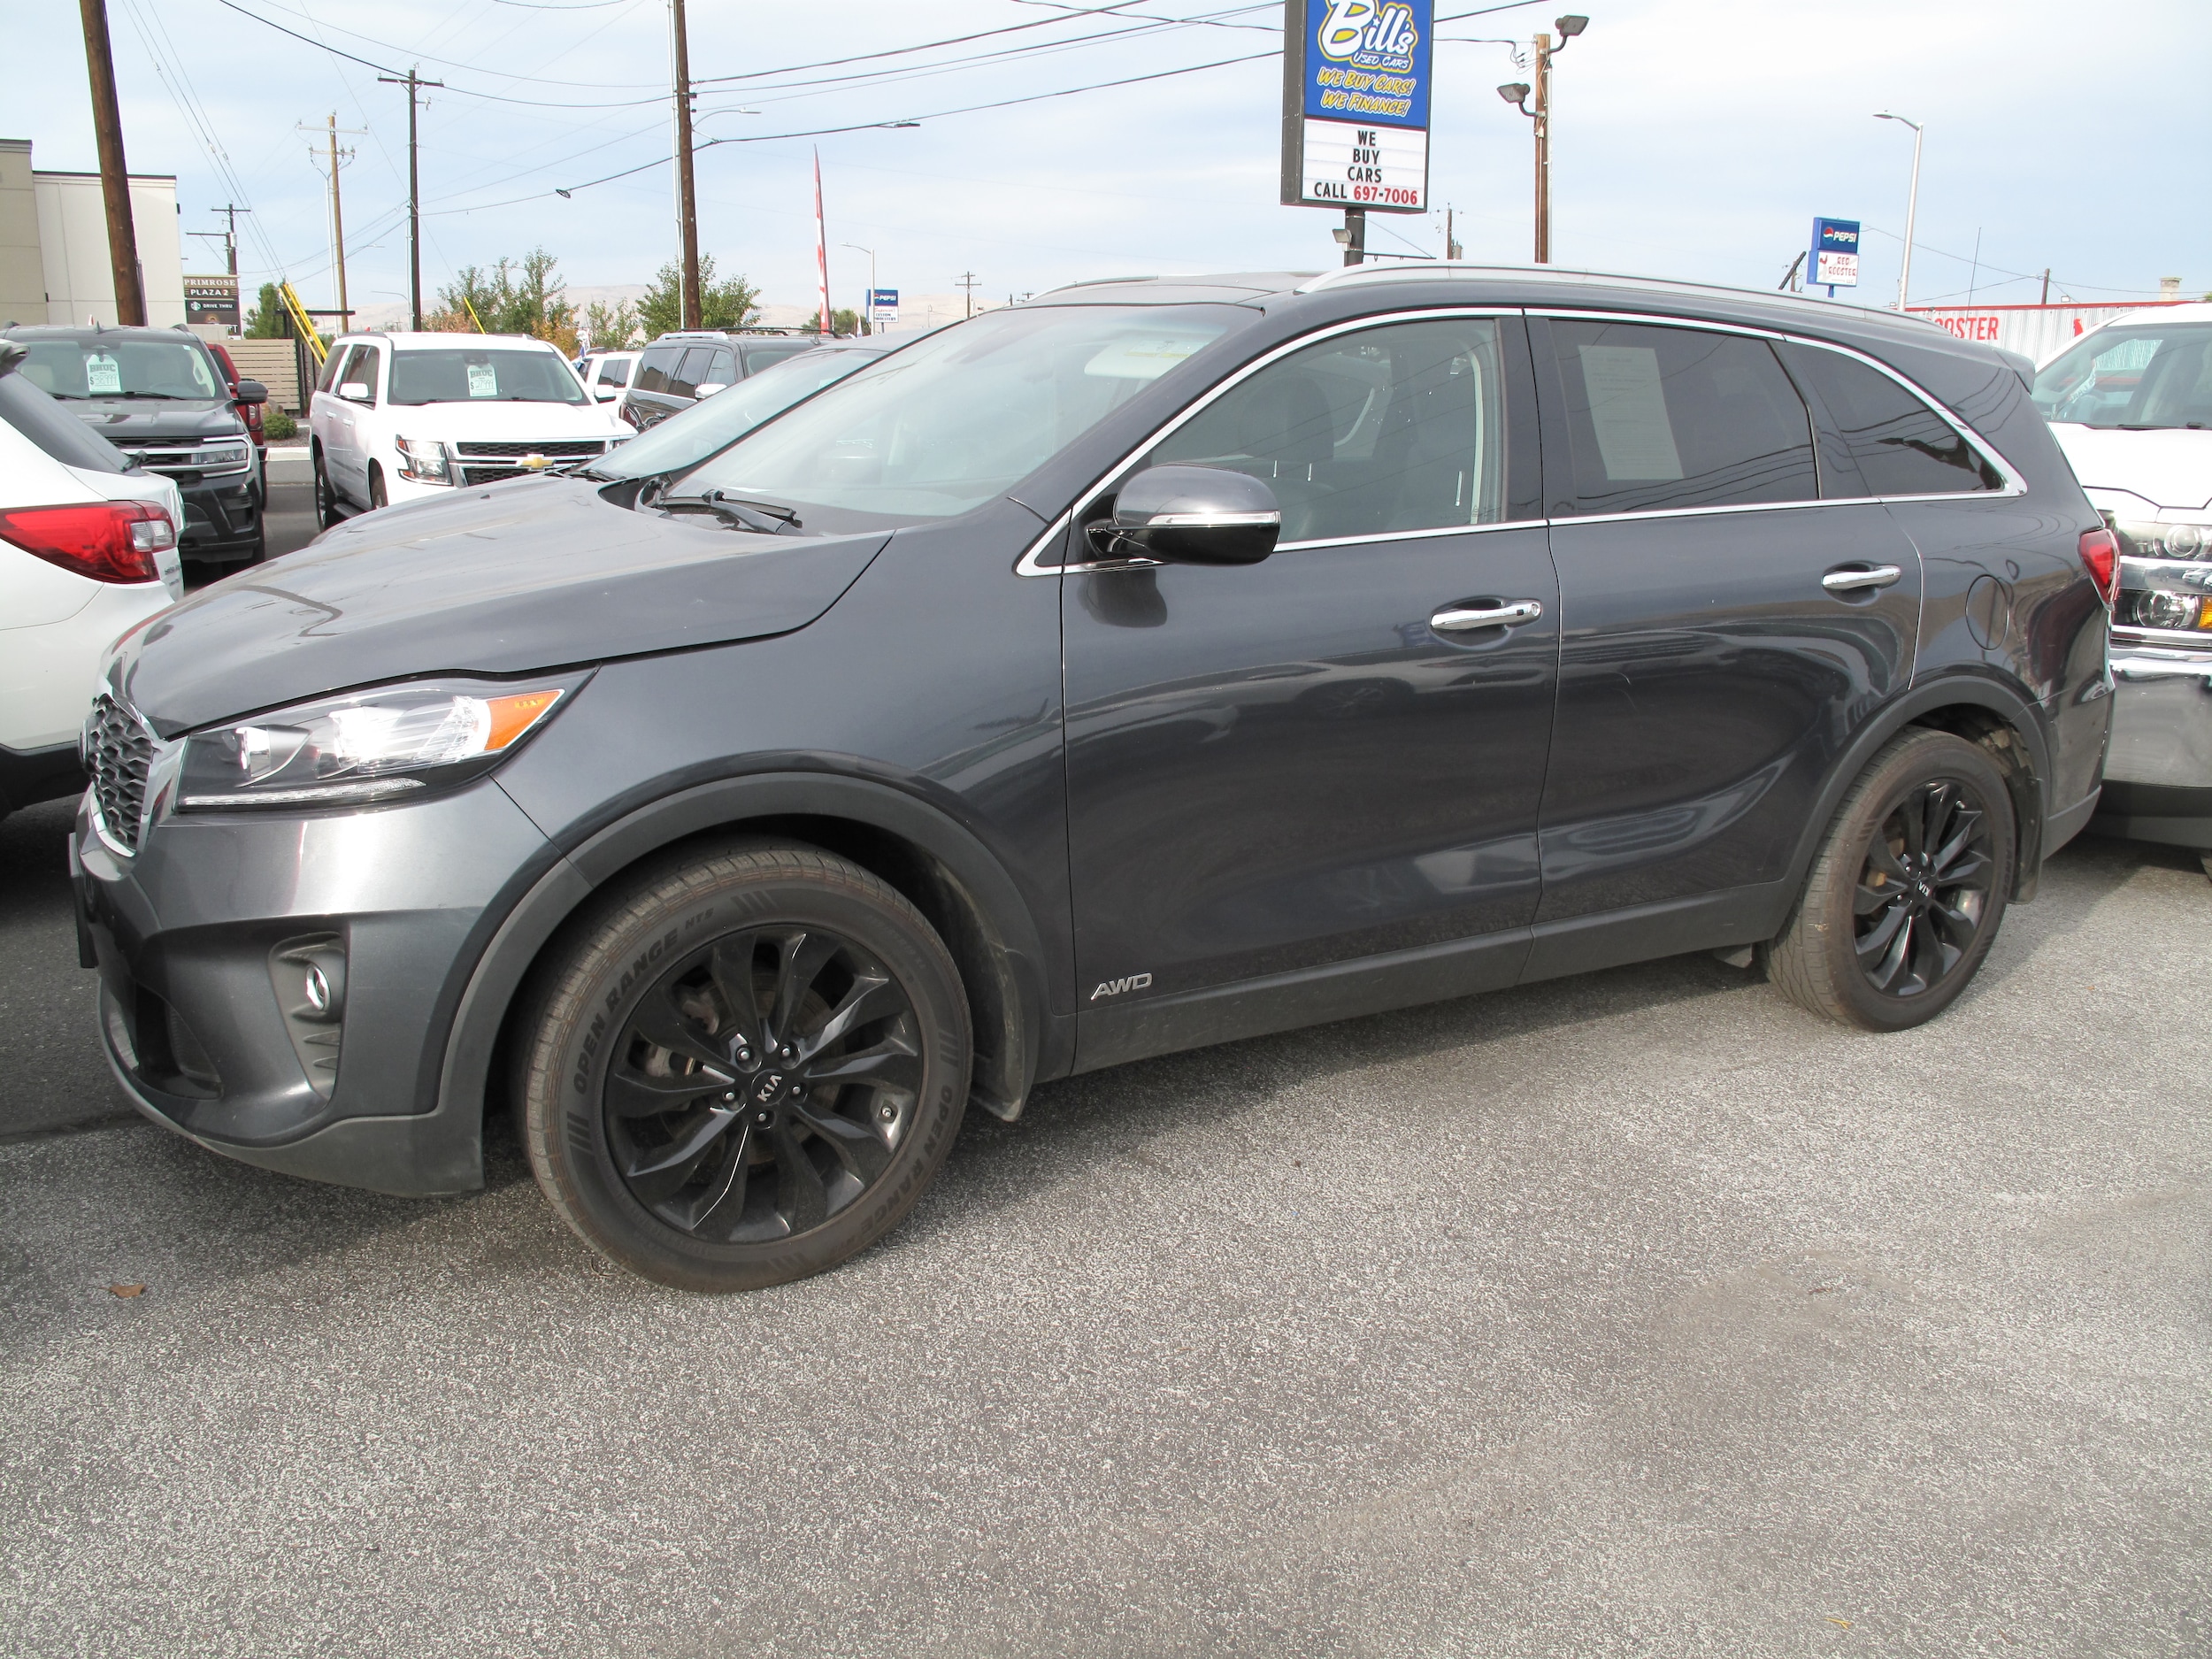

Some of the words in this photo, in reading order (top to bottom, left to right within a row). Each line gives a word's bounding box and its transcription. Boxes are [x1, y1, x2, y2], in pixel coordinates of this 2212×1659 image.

[1322, 0, 1415, 56] Bill's
[1354, 52, 1379, 65] USED
[1382, 56, 1409, 69] CARS
[1318, 68, 1341, 86] WE
[1344, 70, 1374, 90] BUY
[1375, 75, 1416, 96] CARS!
[1321, 91, 1345, 108] WE
[1347, 93, 1410, 116] FINANCE!
[1357, 131, 1376, 146] WE
[1353, 149, 1380, 165] BUY
[1348, 166, 1382, 183] CARS
[1314, 182, 1348, 199] CALL
[1354, 186, 1417, 205] 697-7006
[1833, 231, 1857, 243] PEPSI
[1837, 257, 1850, 265] RED
[1828, 266, 1856, 277] ROOSTER
[1090, 972, 1153, 1002] AWD
[573, 1013, 606, 1095] OPEN
[605, 927, 679, 1013] RANGE
[757, 1074, 783, 1102] KIA
